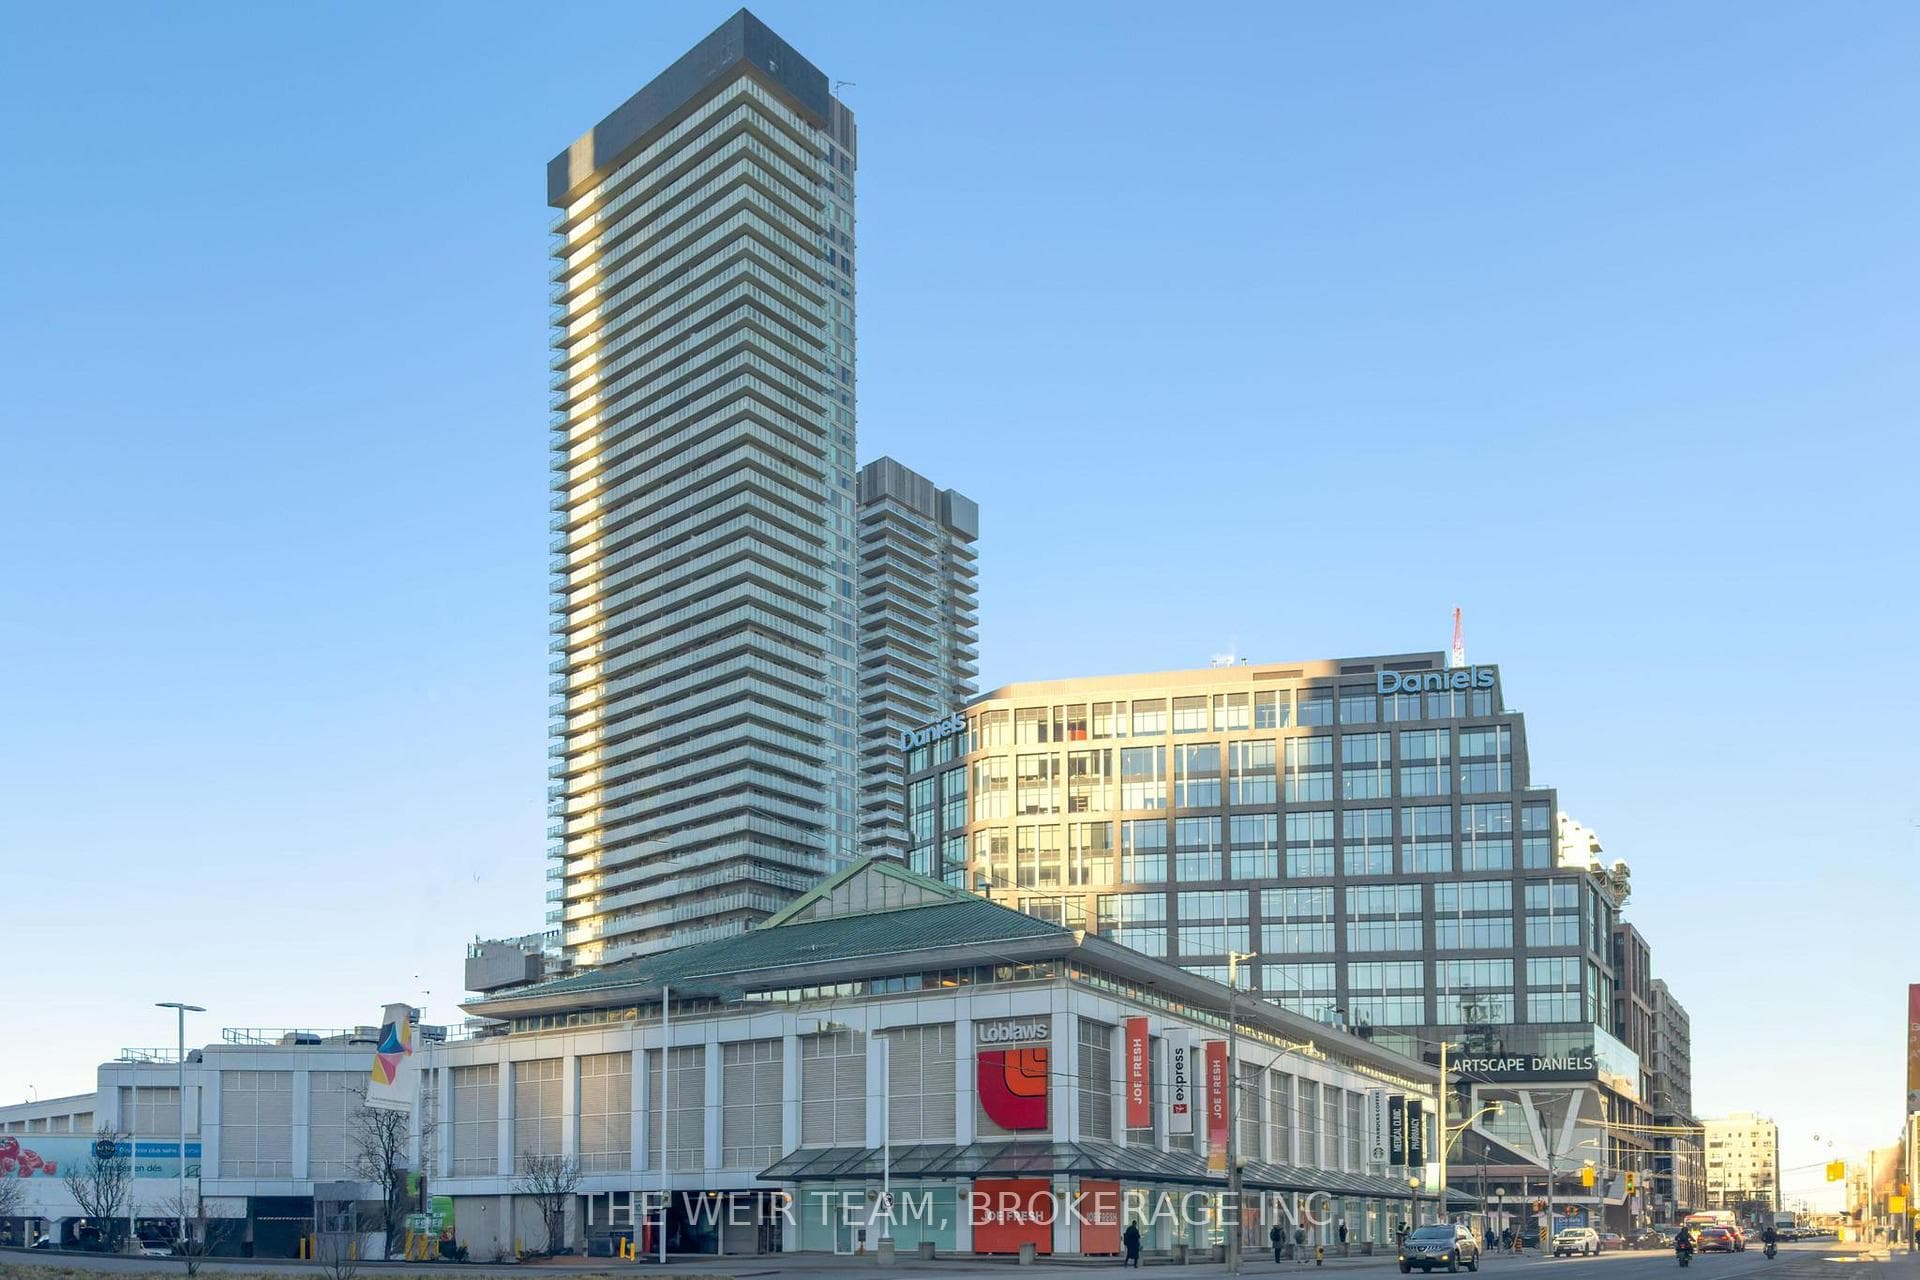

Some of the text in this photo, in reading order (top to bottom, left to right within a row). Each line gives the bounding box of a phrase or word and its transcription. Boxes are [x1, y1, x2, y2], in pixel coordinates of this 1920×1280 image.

[1377, 664, 1495, 694] Daniels
[900, 711, 967, 752] Daniels
[979, 1021, 1049, 1042] Loblaws
[1132, 1038, 1142, 1105] JOE FRESH
[1175, 1047, 1187, 1102] express
[1453, 1057, 1593, 1072] ARTSCAPE DANIELS
[1212, 1059, 1222, 1119] JOE FRESH
[1392, 1108, 1402, 1153] MEDICAL CLINIC
[1411, 1117, 1421, 1150] PHARMACY
[981, 1210, 1044, 1222] JOE FRESH
